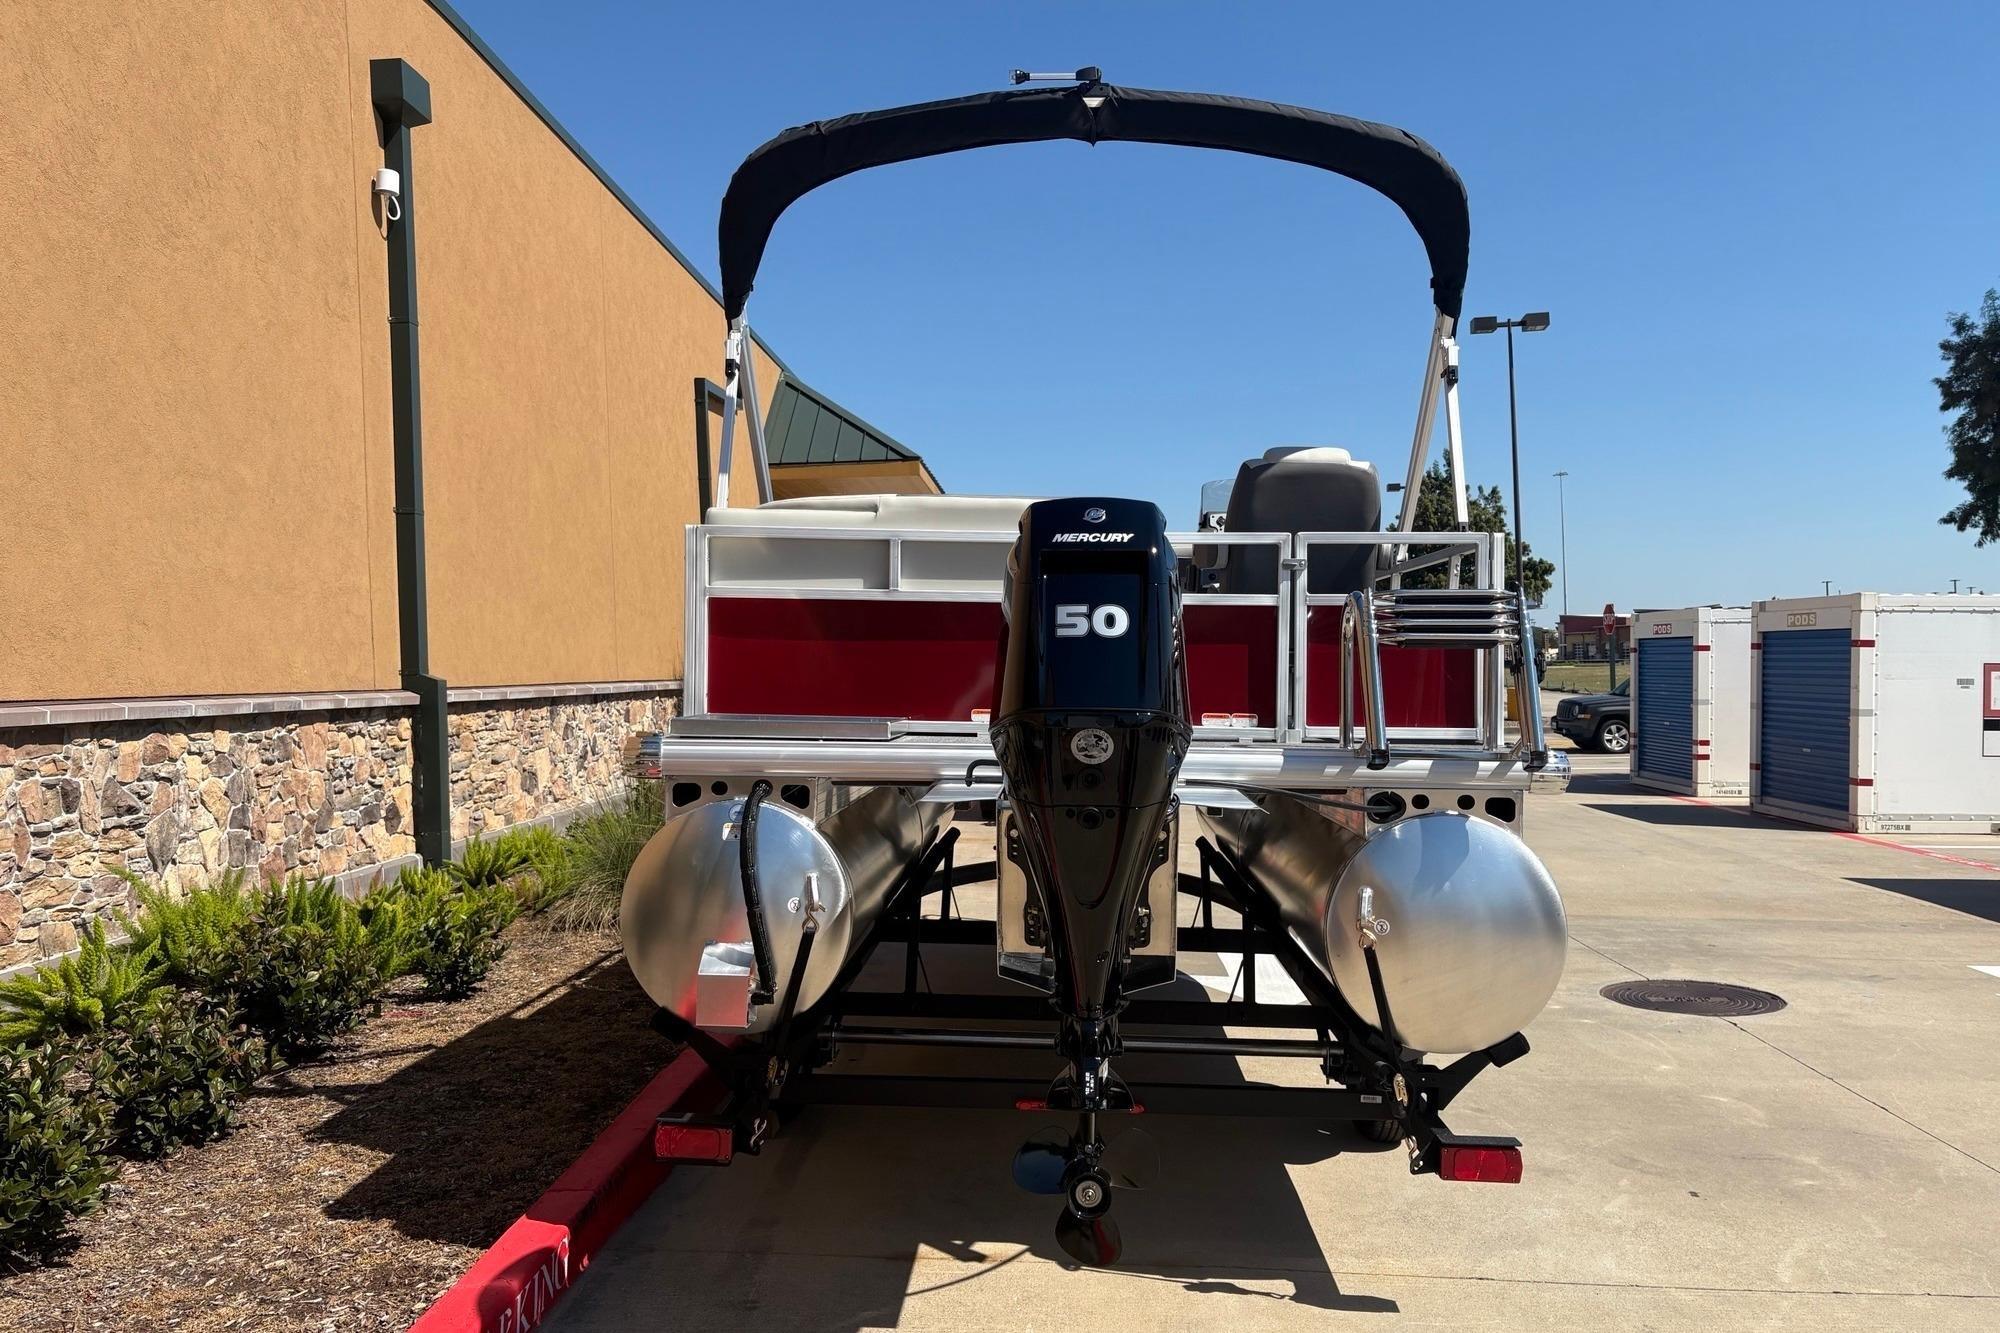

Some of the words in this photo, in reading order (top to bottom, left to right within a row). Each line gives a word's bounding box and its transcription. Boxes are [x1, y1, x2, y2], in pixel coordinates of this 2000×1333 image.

[1052, 533, 1134, 542] MERCURY
[1055, 604, 1130, 638] 50
[1787, 613, 1816, 626] PODS
[1653, 625, 1672, 634] PODS
